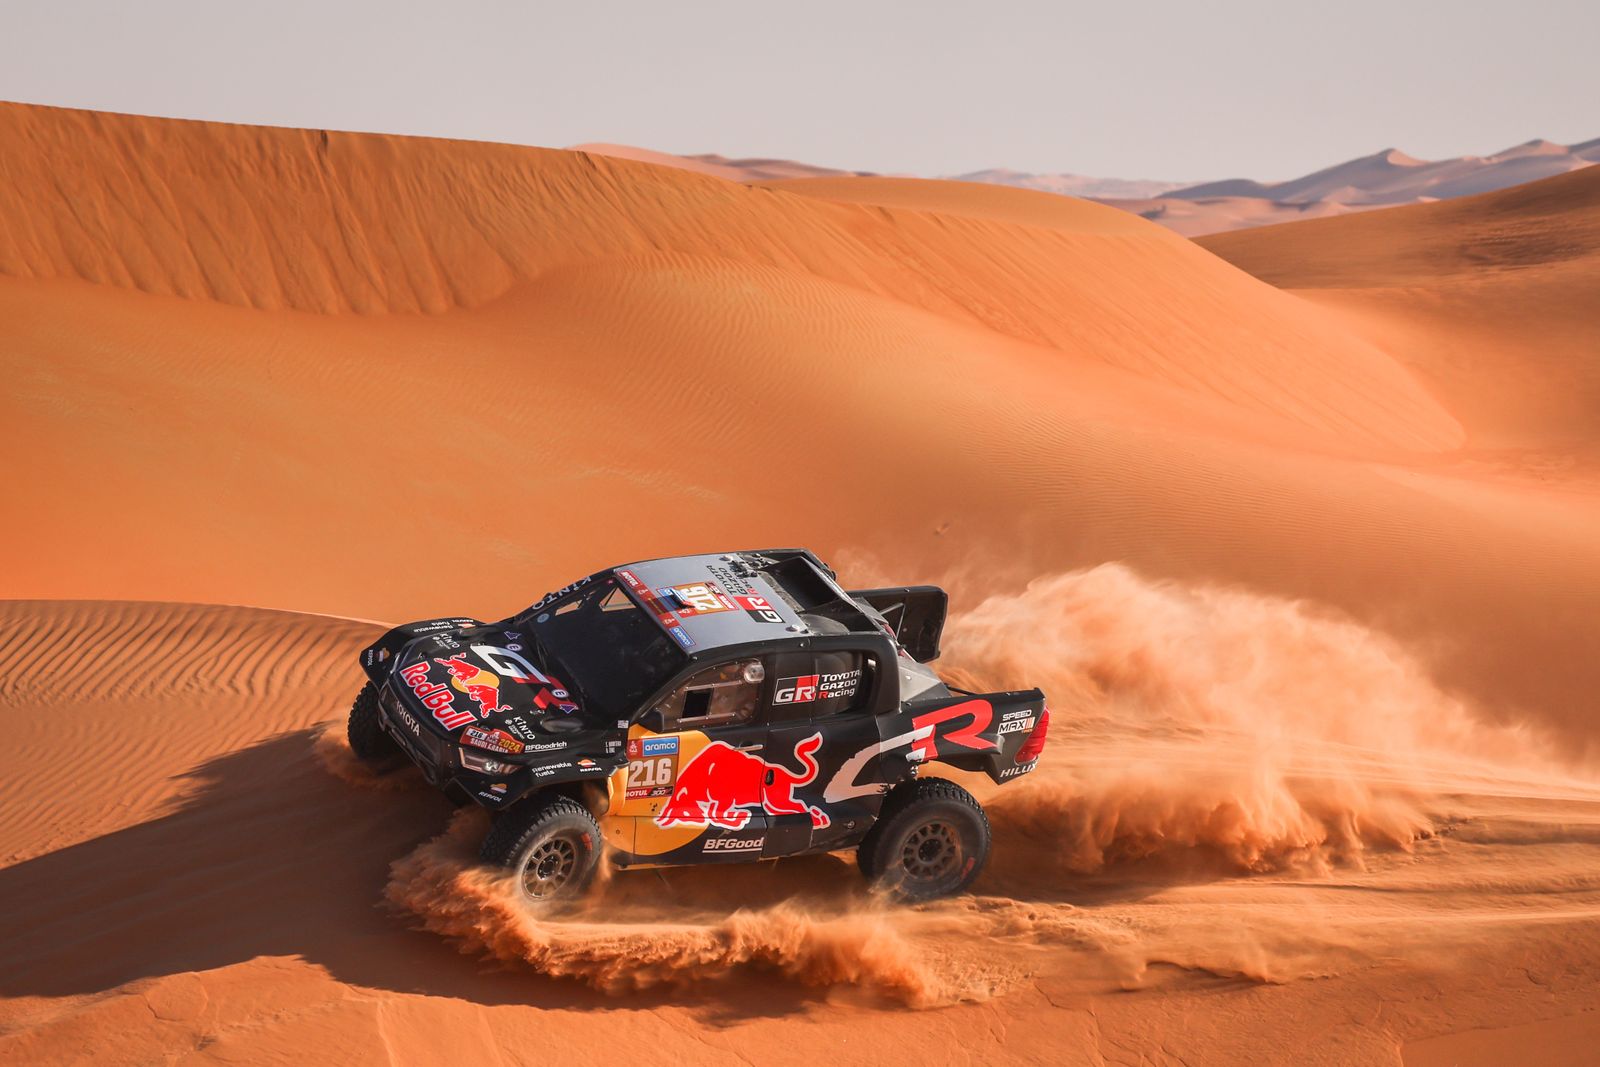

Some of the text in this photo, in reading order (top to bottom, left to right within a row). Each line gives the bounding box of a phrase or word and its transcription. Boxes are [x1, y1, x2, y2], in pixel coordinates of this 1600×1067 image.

[706, 565, 737, 595] TOYOTA
[719, 567, 748, 595] GAZOO
[682, 586, 724, 611] 216
[746, 597, 783, 623] GR
[821, 669, 861, 682] TOYOTA
[820, 679, 857, 691] GAZOO
[400, 661, 478, 731] Red Bull
[775, 685, 816, 703] GR
[818, 687, 855, 699] Racing
[396, 700, 421, 736] TOYOTA
[1002, 709, 1032, 721] SPEED
[999, 719, 1025, 732] MAX
[498, 738, 521, 753] 2024
[525, 741, 567, 751] BFGoodrich
[645, 742, 676, 751] aramco
[532, 762, 572, 773] Renewable
[536, 770, 555, 778] fuels
[628, 758, 672, 787] 216
[1000, 763, 1038, 778] HILUX
[703, 837, 765, 850] BFGood
